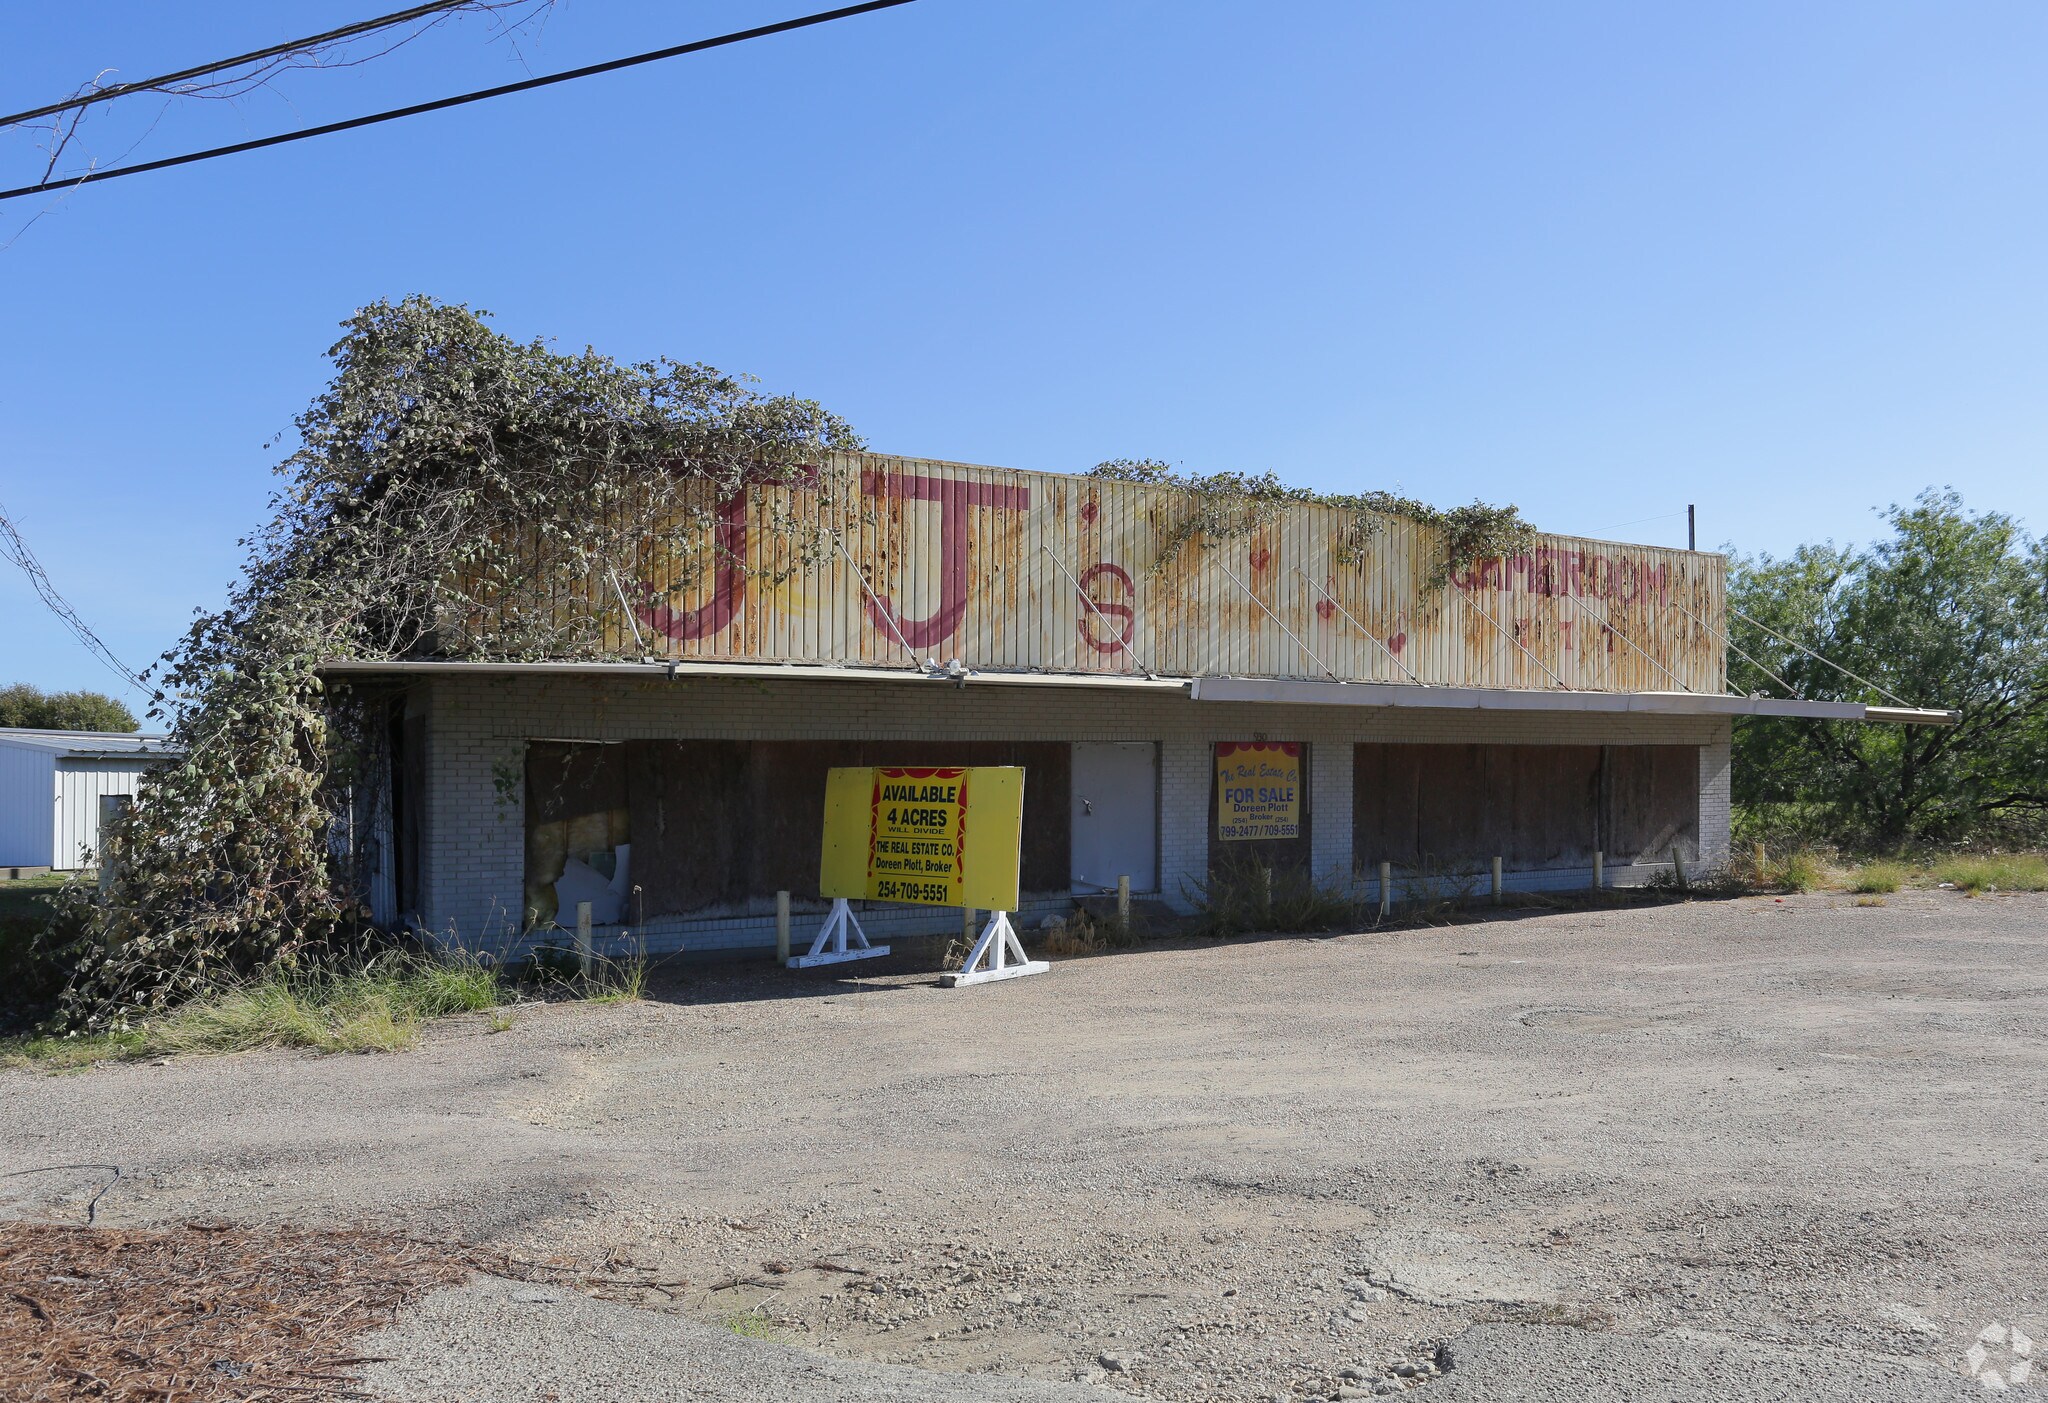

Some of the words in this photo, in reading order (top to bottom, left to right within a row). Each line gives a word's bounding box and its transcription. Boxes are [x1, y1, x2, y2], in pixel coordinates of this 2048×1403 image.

[1220, 769, 1235, 784] The
[1237, 764, 1256, 778] Real
[1259, 763, 1284, 779] Estate
[882, 785, 956, 803] AVAILABLE
[1225, 788, 1254, 803] FOR
[1259, 787, 1294, 803] SALE
[1233, 804, 1266, 813] Doreen
[1268, 803, 1288, 812] Plott
[887, 808, 897, 824] 4
[901, 808, 947, 827] ACRES
[1232, 817, 1248, 825] (254)
[1250, 813, 1273, 821] Broker
[1275, 816, 1289, 824] (254)
[913, 827, 945, 835] DIVIDE
[876, 841, 889, 853] THE
[891, 841, 909, 854] REAL
[911, 842, 939, 856] ESTATE
[941, 843, 954, 857] CO.
[876, 857, 902, 870] Doreen
[904, 858, 923, 873] Plott,
[925, 860, 952, 873] Broker
[878, 881, 948, 902] 254-709-5551
